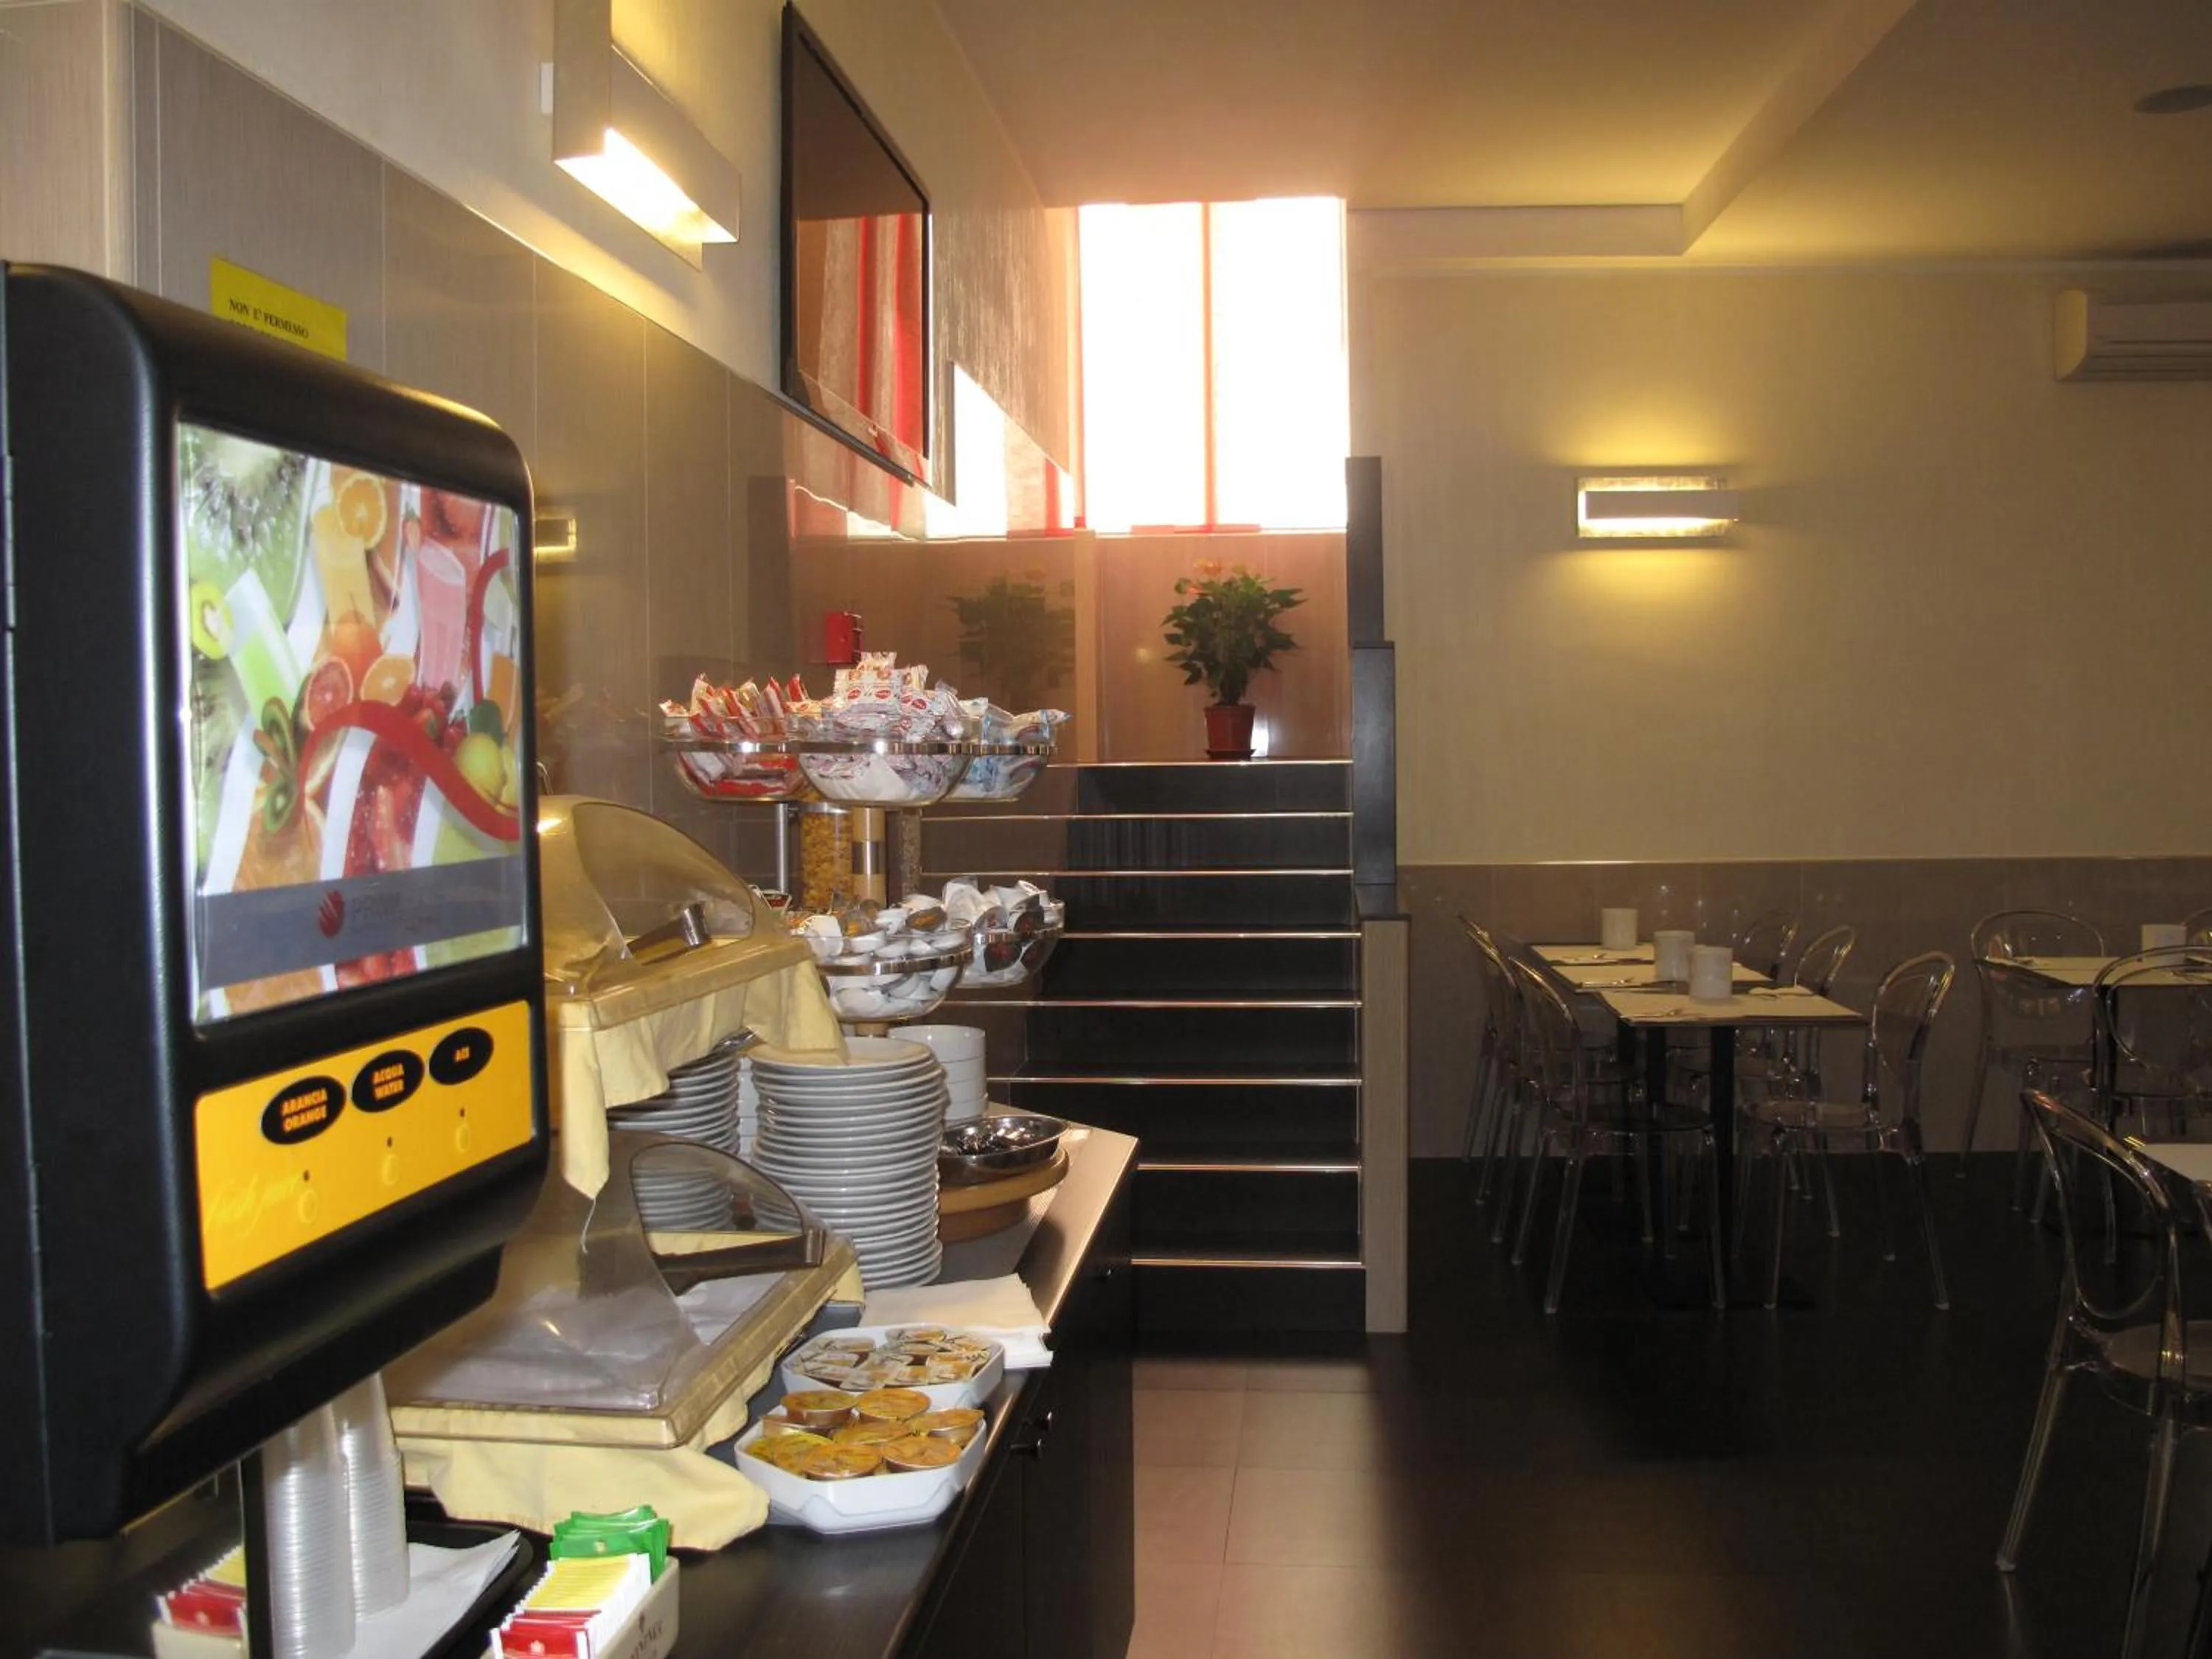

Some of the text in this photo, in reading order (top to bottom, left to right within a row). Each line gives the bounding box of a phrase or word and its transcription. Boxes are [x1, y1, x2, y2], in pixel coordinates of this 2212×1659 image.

[229, 296, 250, 317] NON
[263, 311, 310, 340] PERMISSO
[372, 1062, 405, 1085] ACQUA
[282, 1088, 328, 1116] ARANCIA
[375, 1079, 405, 1100] WATER
[283, 1105, 327, 1133] ORANGE
